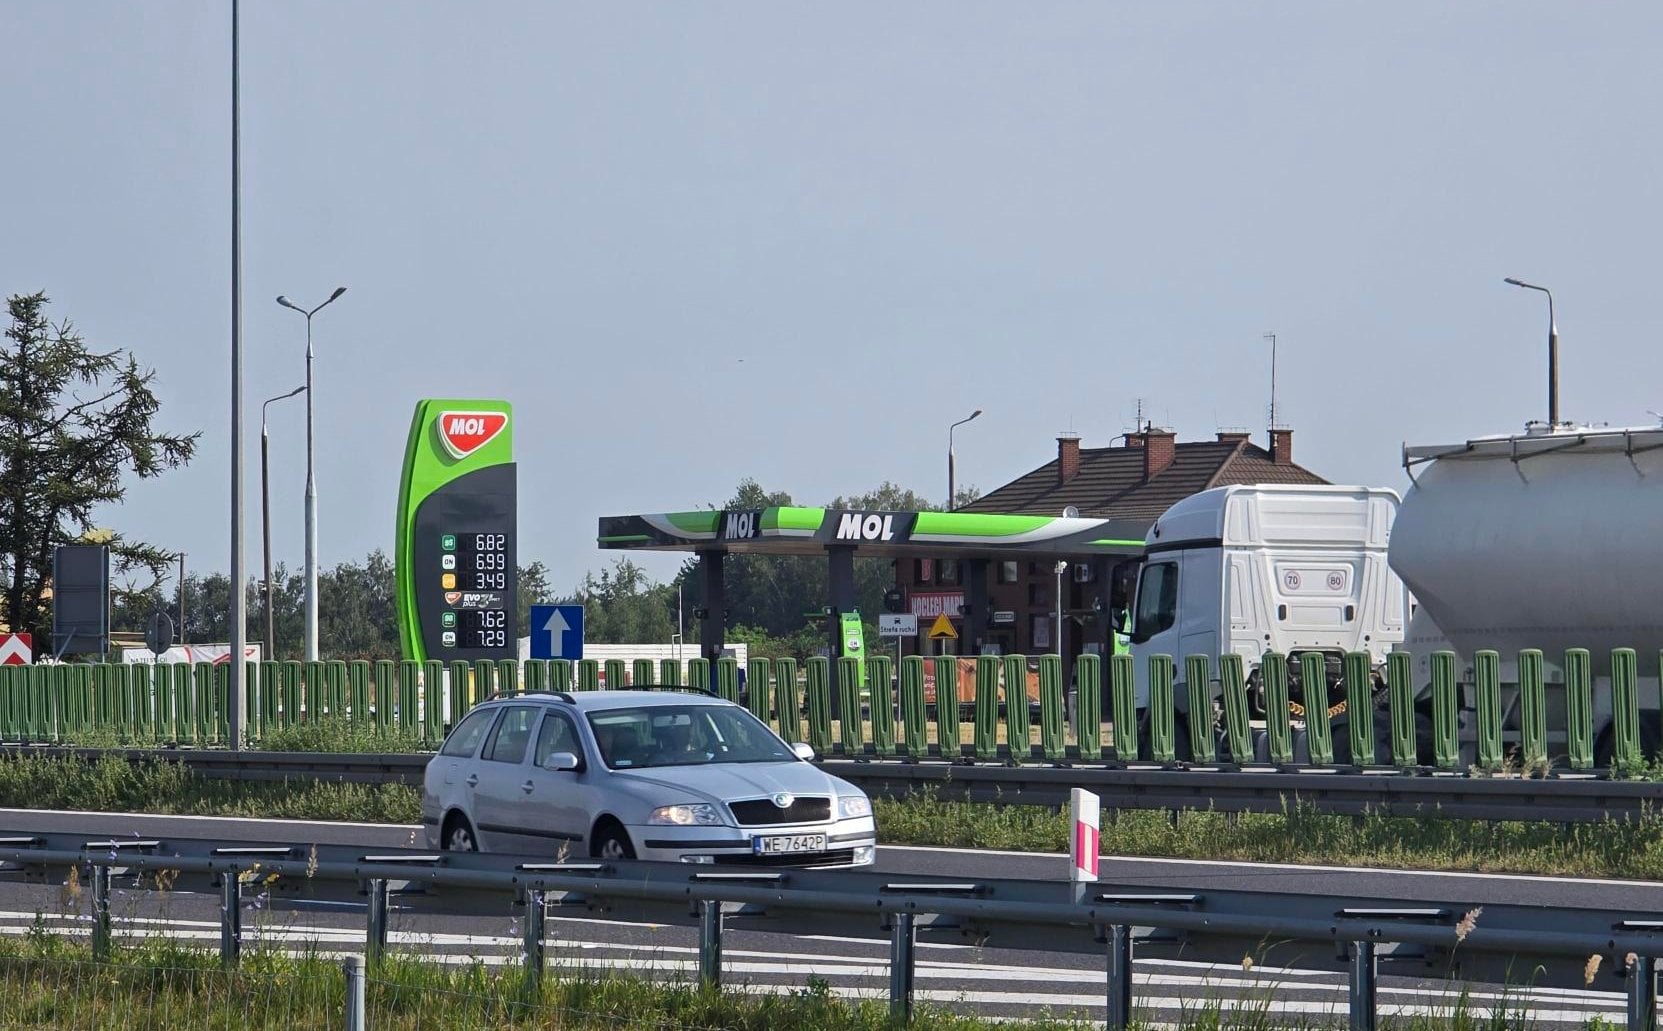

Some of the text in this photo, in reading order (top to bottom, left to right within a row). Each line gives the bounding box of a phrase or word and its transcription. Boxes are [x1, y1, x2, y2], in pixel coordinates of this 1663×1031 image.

[449, 418, 485, 435] MOL
[725, 513, 755, 540] MOL
[836, 513, 894, 541] MOL
[1287, 575, 1298, 585] 70
[1330, 576, 1341, 586] 80
[463, 593, 481, 601] EVO
[911, 596, 942, 616] NOCLEGI
[763, 838, 780, 852] WE
[785, 836, 823, 851] 7642P
